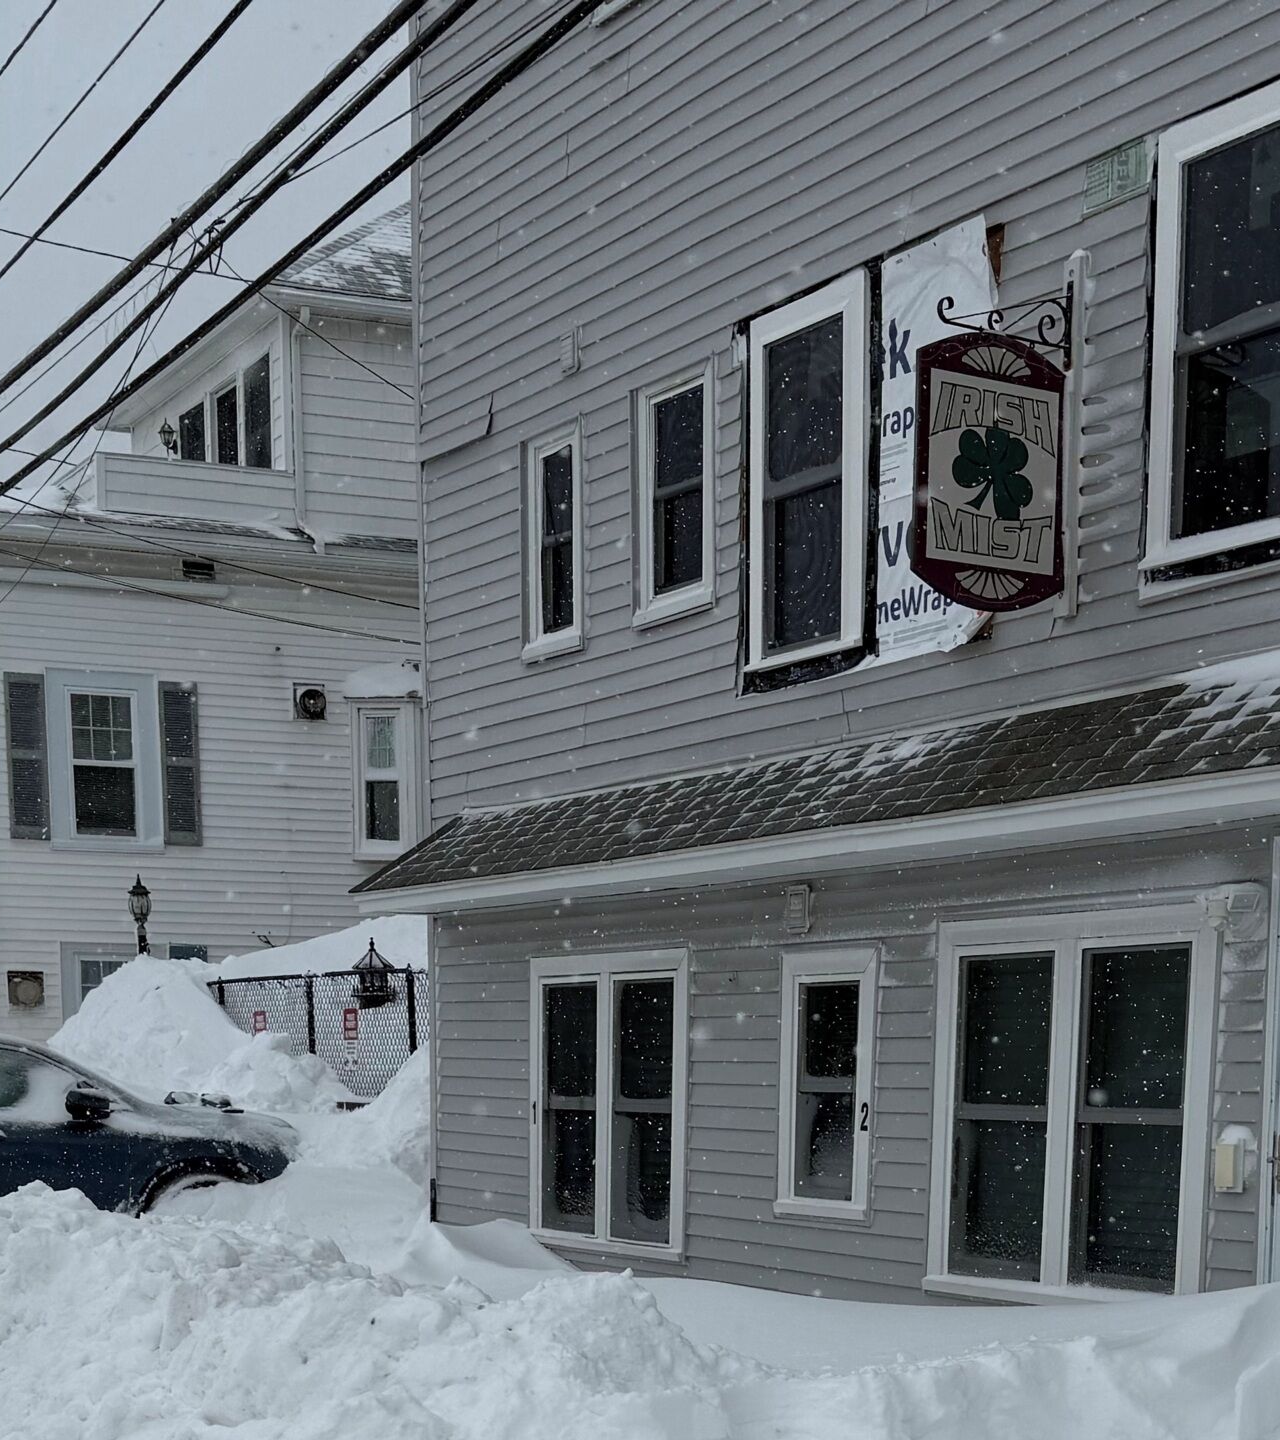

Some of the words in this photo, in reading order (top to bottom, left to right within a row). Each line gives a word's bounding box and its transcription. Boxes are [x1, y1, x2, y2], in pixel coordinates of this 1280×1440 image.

[929, 381, 1056, 459] IRISH
[930, 496, 1054, 564] MIST
[860, 1102, 869, 1131] 2
